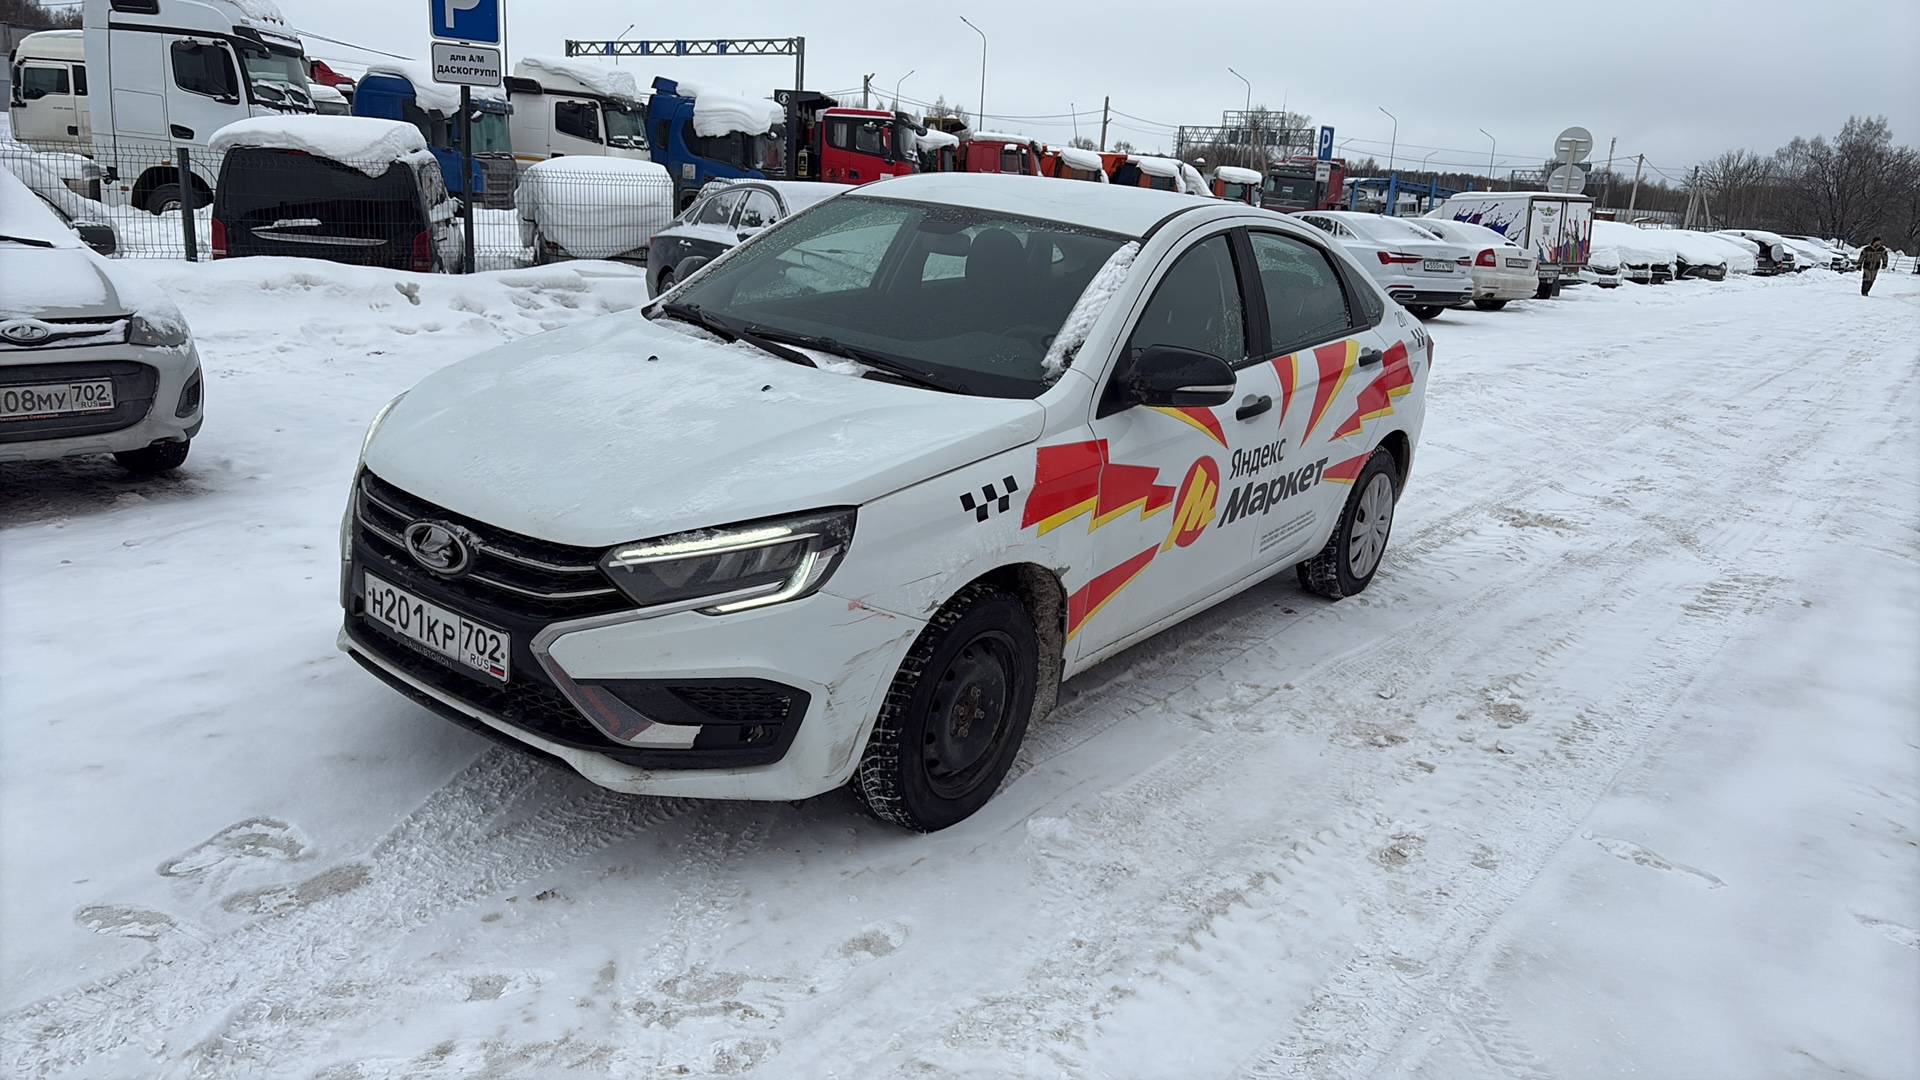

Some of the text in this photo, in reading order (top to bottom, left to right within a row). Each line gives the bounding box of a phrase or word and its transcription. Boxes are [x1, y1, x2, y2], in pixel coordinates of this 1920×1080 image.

[437, 64, 498, 78] ДАСКОГРУПП
[450, 54, 466, 62] для
[1320, 130, 1331, 157] P
[0, 384, 106, 413] 08МУ 702
[81, 400, 98, 408] RUS
[1229, 438, 1287, 480] Яндекс
[1217, 457, 1329, 528] Маркет
[372, 587, 456, 650] Н201КР
[461, 620, 501, 663] 702
[470, 653, 490, 670] RUS
